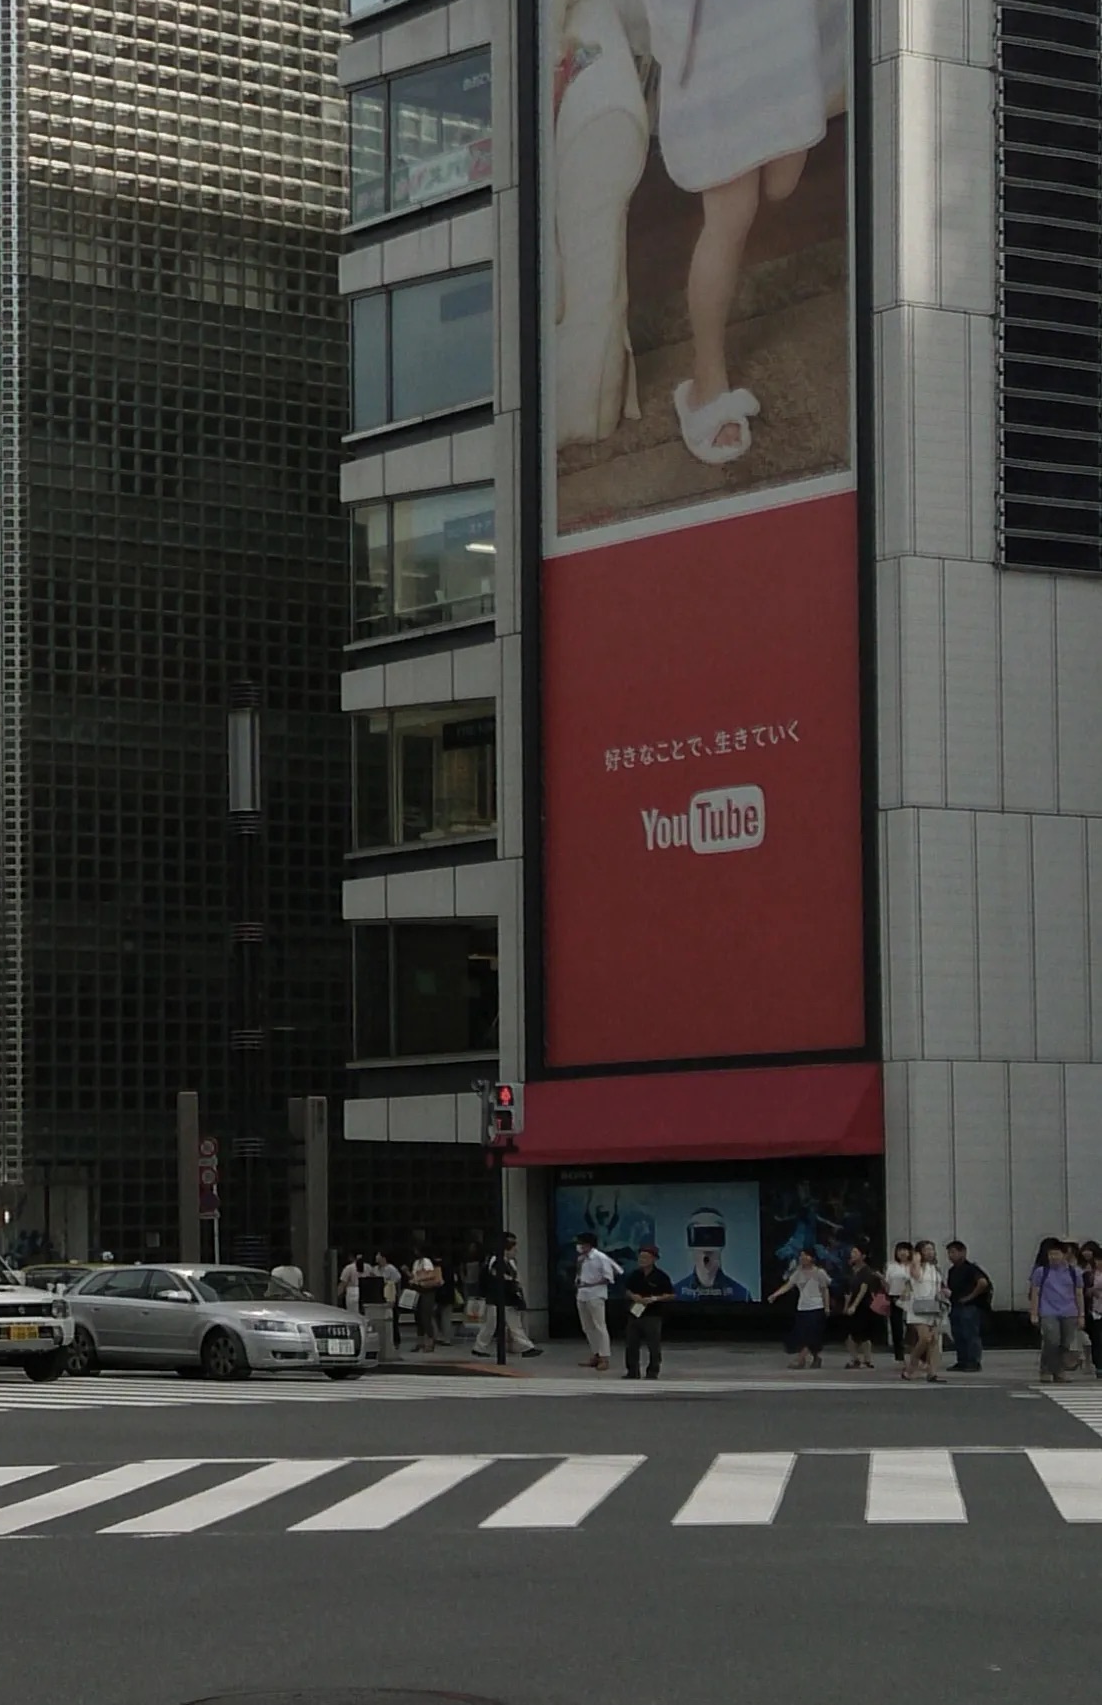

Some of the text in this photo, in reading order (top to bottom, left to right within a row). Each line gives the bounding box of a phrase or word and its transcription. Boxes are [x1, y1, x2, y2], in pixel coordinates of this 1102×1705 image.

[604, 720, 802, 772] 好きなことで、生きていく
[641, 790, 762, 852] YouTube
